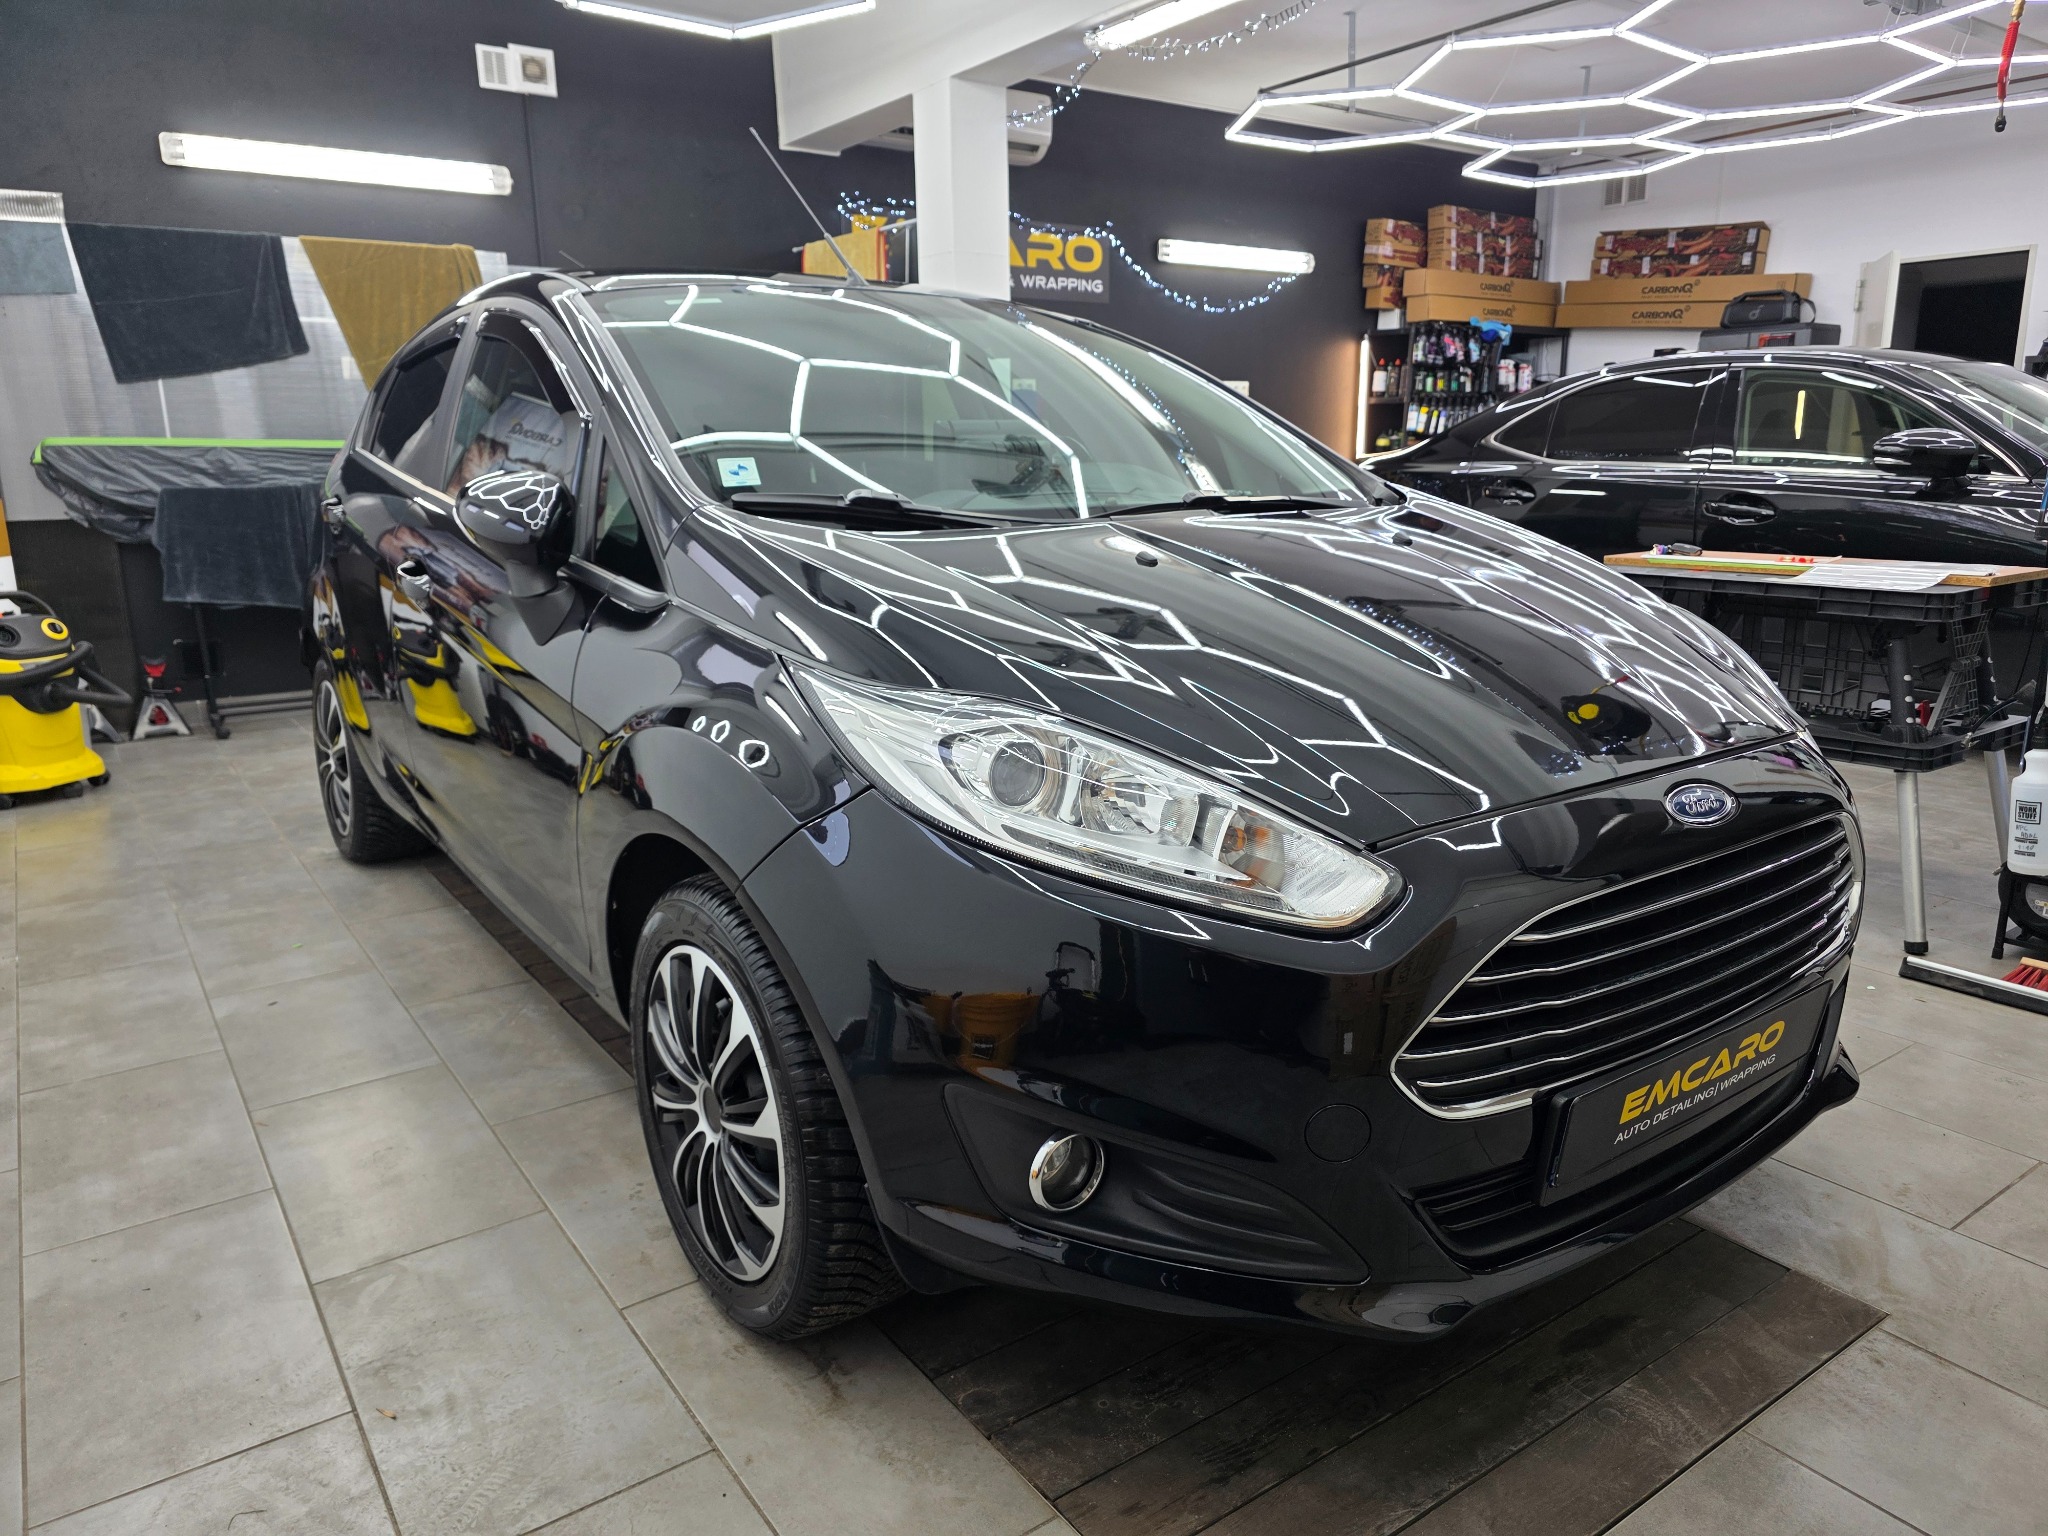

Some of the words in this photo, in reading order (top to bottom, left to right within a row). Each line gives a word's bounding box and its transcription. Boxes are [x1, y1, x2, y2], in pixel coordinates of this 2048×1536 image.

[1019, 274, 1104, 294] WRAPPING
[1641, 283, 1693, 295] CARBONQ
[1632, 308, 1683, 320] CARBONQ
[1681, 788, 1720, 816] Ford
[1619, 1020, 1786, 1125] EMCARO
[1613, 1119, 1651, 1145] AUTO
[1720, 1053, 1776, 1091] WRAPPING
